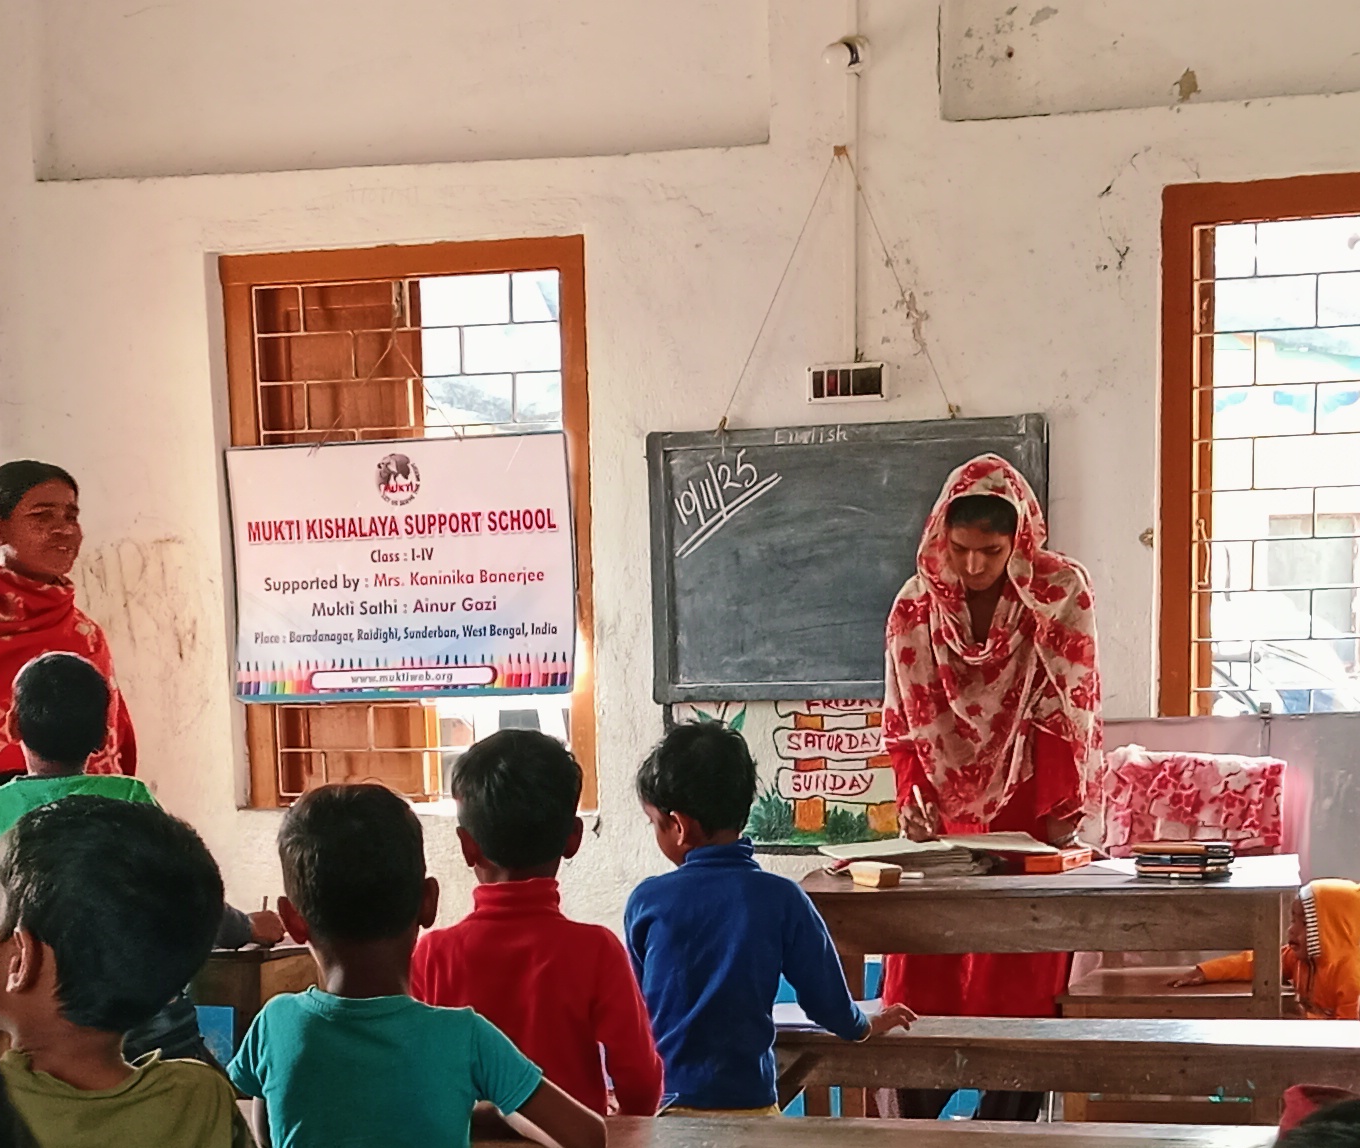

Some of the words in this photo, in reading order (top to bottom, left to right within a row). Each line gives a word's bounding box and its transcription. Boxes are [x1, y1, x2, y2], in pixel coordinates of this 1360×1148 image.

[674, 449, 758, 526] 10/11/25
[248, 519, 301, 542] MUKTI
[306, 515, 400, 540] KISHALAYA
[404, 511, 482, 536] SUPPORT
[487, 508, 557, 531] SCHOOL
[370, 549, 400, 563] Class
[411, 547, 434, 561] I-IV
[264, 573, 338, 595] Supported
[342, 573, 360, 593] by
[373, 573, 405, 588] Mrs.
[410, 569, 474, 586] Kaninika
[479, 566, 545, 586] Banerjee
[311, 601, 355, 618] Mukti
[359, 599, 398, 616] Sathi
[412, 597, 456, 614] Ainur
[461, 595, 497, 612] Gazi
[254, 631, 280, 645] Place
[403, 624, 460, 640] Sunderban,
[462, 624, 487, 638] West
[489, 622, 529, 639] Bengal,
[531, 622, 558, 636] India
[787, 732, 882, 753] SATURDAY
[791, 773, 874, 796] SUNDAY
